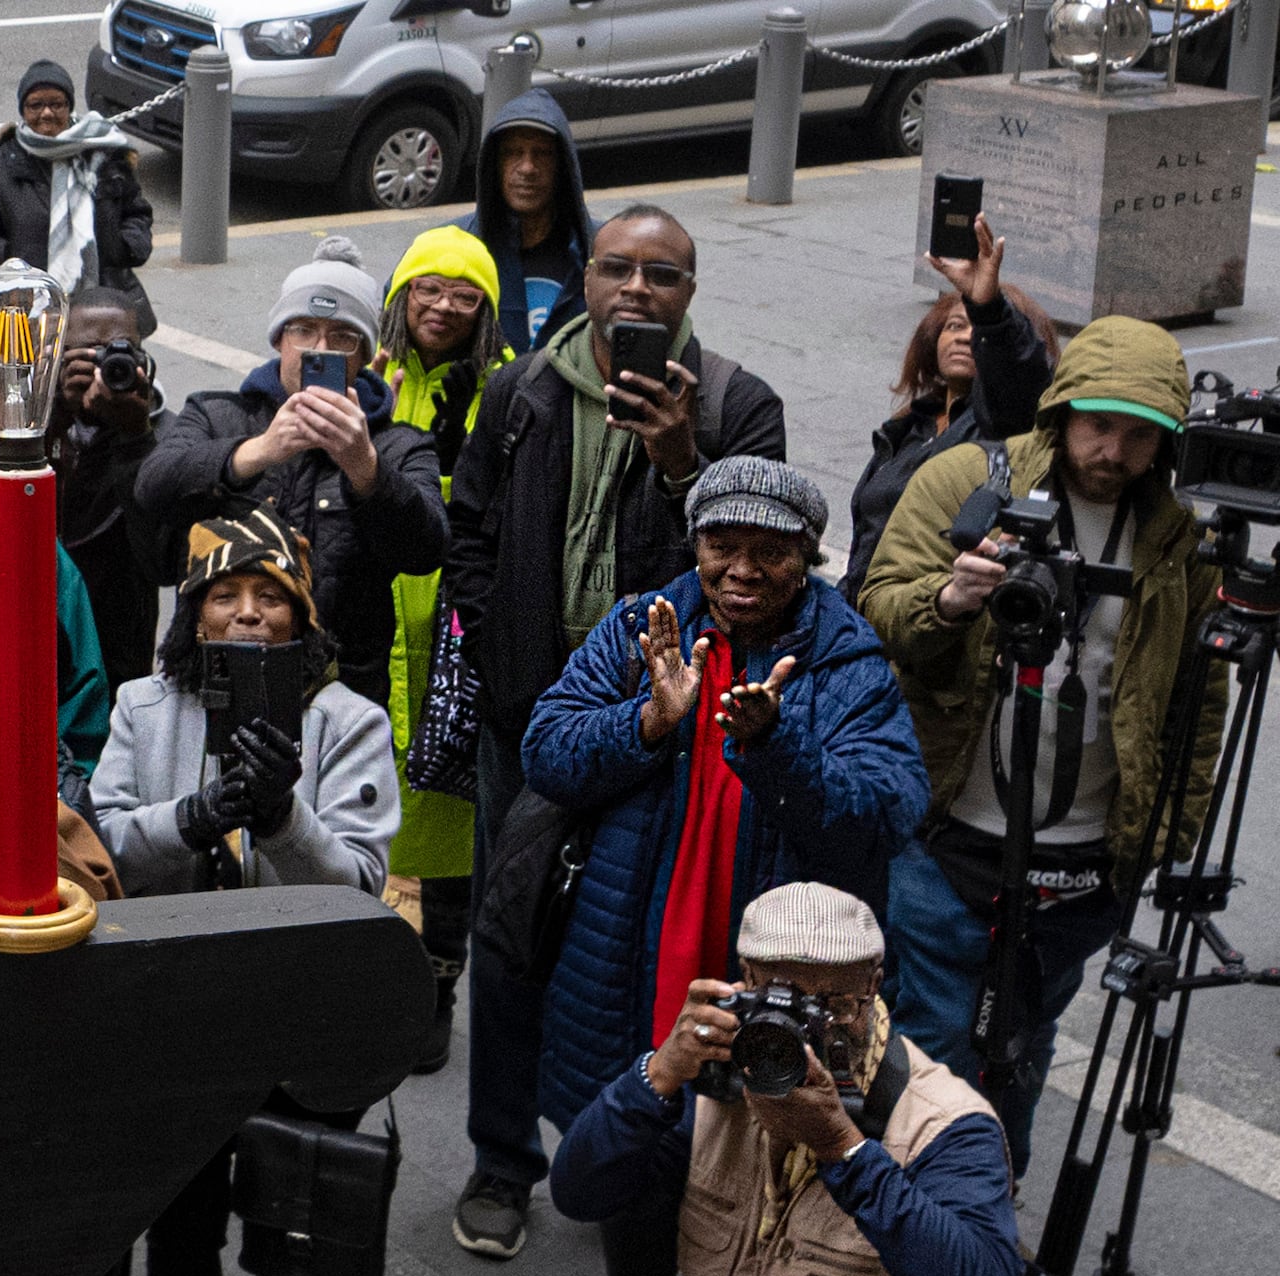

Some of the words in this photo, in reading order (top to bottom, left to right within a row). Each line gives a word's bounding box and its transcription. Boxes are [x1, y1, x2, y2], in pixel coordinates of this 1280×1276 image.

[998, 115, 1029, 138] XV
[1156, 152, 1206, 169] ALL
[1114, 186, 1242, 213] PEOPLES
[976, 987, 996, 1038] SONY
